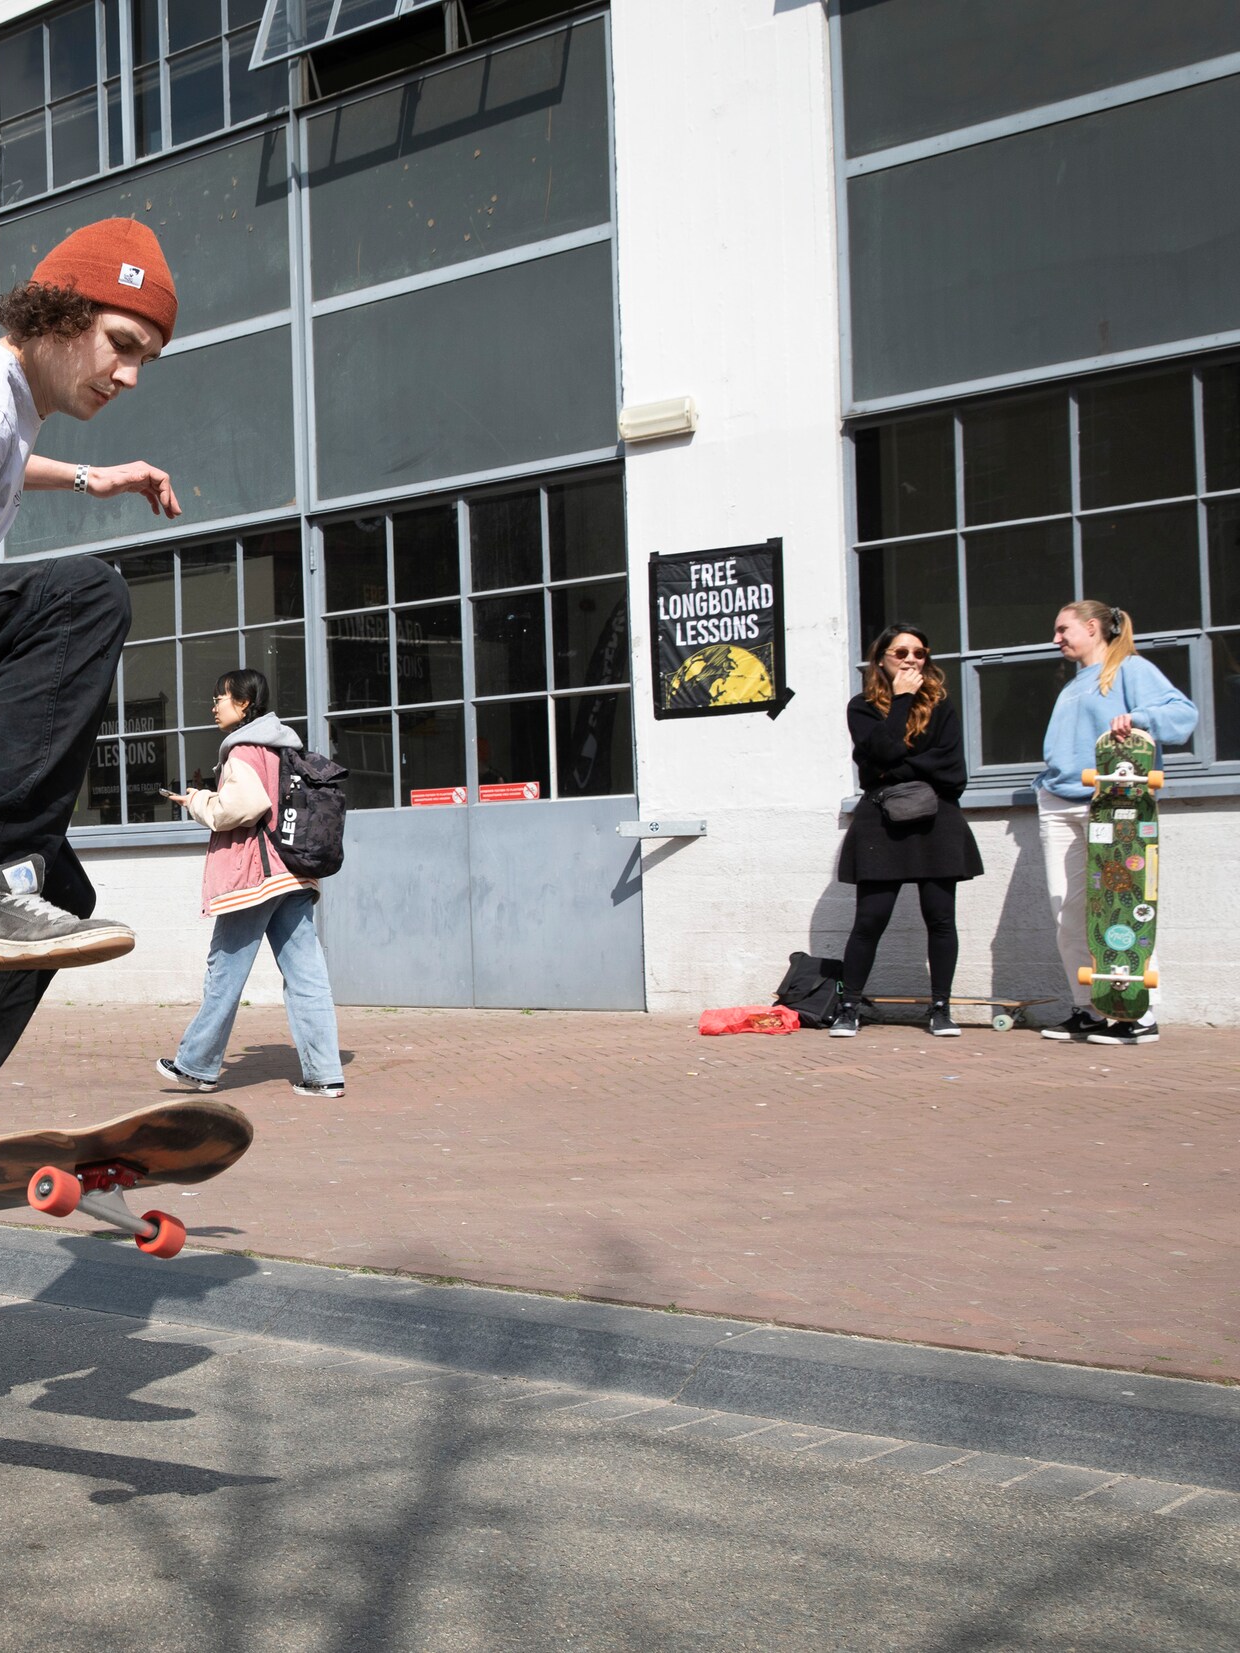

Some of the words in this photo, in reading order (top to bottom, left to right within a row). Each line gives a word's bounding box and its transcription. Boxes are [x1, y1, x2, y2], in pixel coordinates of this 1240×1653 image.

[691, 560, 738, 589] FREE
[659, 583, 774, 620] LONGBOARD
[675, 613, 759, 647] LESSONS
